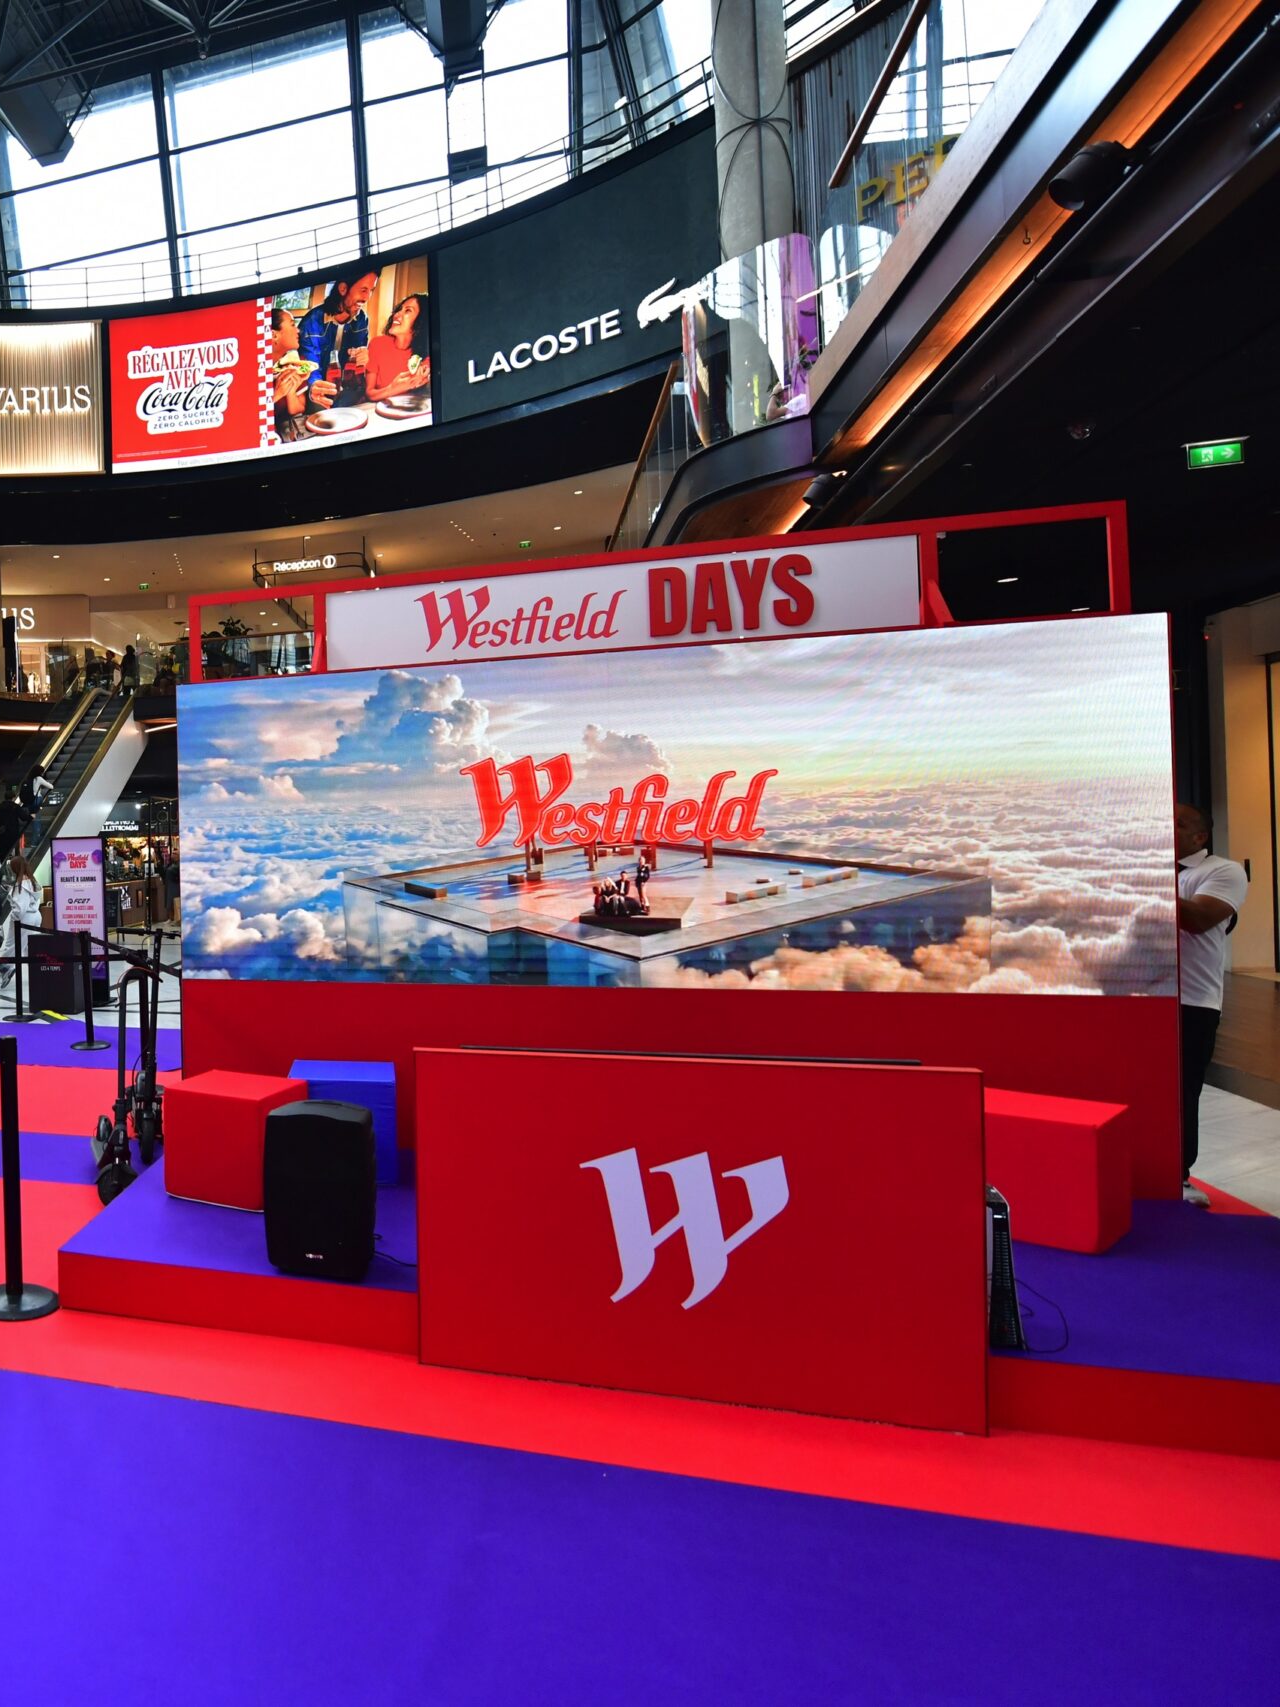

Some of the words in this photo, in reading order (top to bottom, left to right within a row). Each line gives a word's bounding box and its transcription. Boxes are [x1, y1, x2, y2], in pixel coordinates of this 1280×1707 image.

[468, 308, 622, 384] LACOSTE
[131, 342, 234, 375] RÉGALEZ-VOUS
[166, 368, 202, 391] AVEC
[157, 414, 179, 422] ZERO
[182, 410, 215, 419] SUCRES
[178, 416, 220, 427] CALORIES
[273, 559, 321, 572] Réception
[414, 585, 628, 653] Westfield
[647, 553, 815, 638] DAYS
[459, 752, 779, 848] Westfield
[70, 860, 87, 869] DAYS
